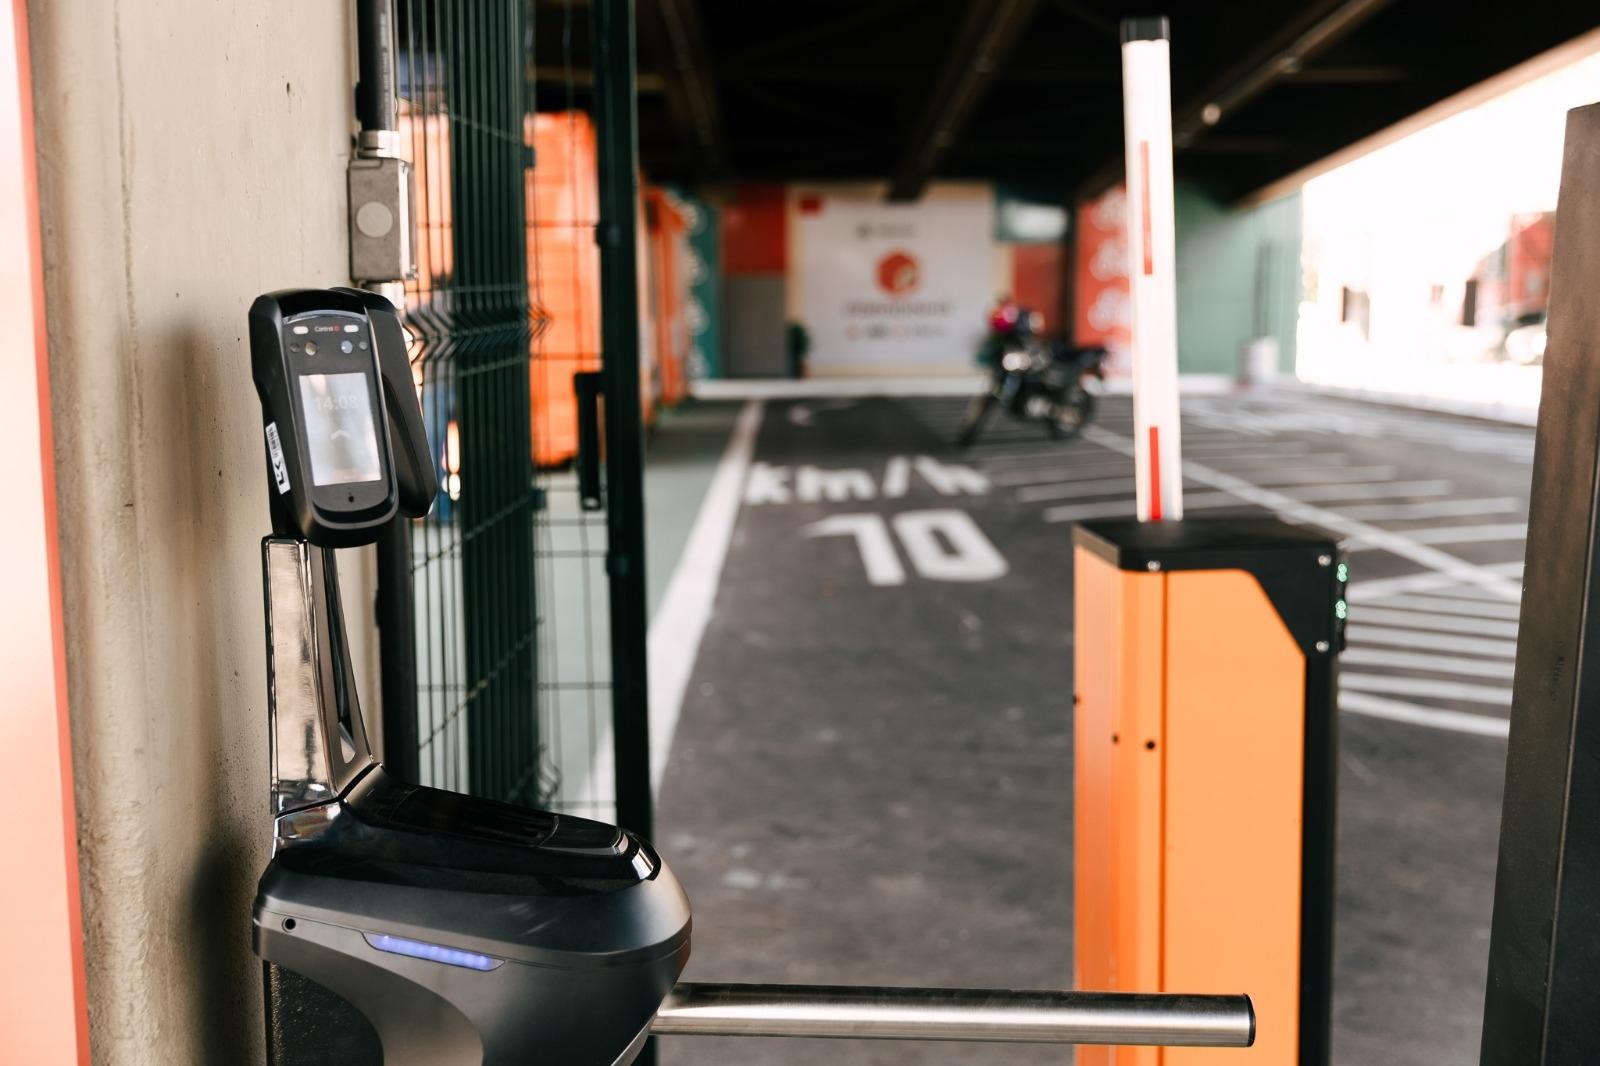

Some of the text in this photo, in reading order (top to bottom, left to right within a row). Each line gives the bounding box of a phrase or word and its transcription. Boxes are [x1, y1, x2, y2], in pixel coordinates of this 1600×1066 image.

[313, 395, 359, 411] 14:08
[746, 455, 991, 503] km/h
[806, 510, 1008, 585] 10
